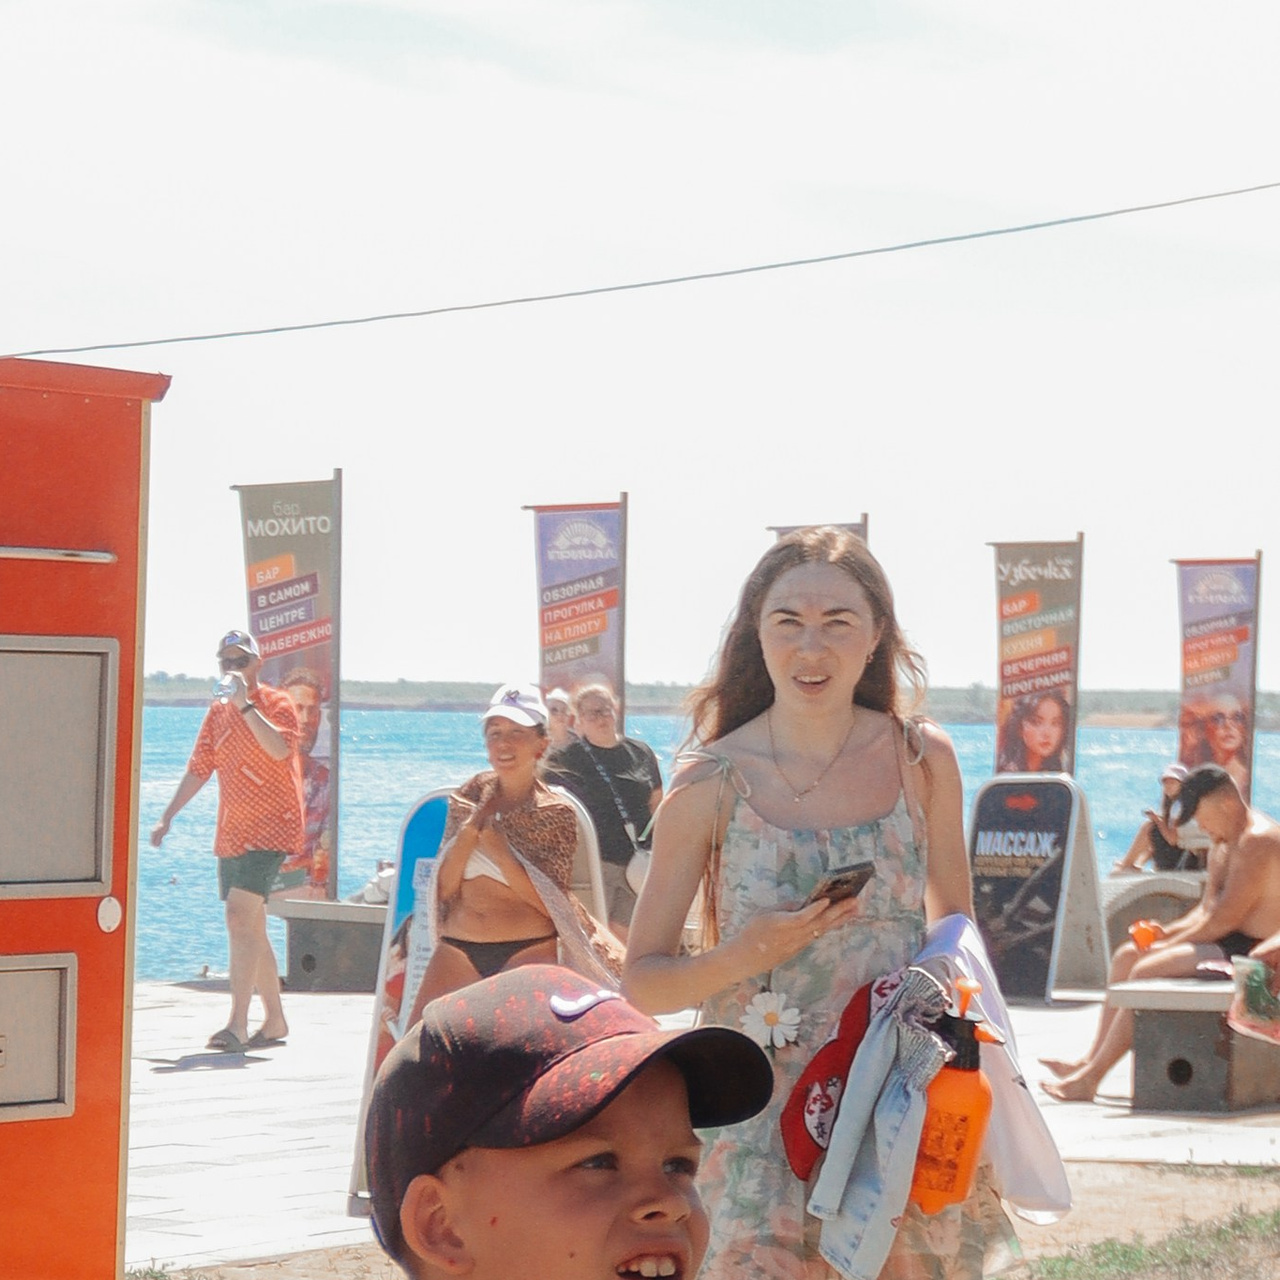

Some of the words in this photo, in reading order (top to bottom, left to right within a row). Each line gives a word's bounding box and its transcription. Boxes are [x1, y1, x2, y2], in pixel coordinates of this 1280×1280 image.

[247, 516, 331, 538] МОХИТО
[256, 566, 280, 584] БАР
[257, 595, 267, 608] В
[268, 581, 310, 605] САМОМ
[543, 576, 604, 603] ОБЗОРНАЯ
[259, 607, 306, 632] ЦЕНТРЕ
[543, 597, 604, 624] ПРОГУЛКА
[545, 629, 563, 644] НА
[545, 643, 590, 664] КАТЕРА
[1003, 651, 1068, 676] ВЕЧЕРНЯЯ
[1003, 670, 1072, 696] ПРОГРАММ
[976, 831, 1056, 856] МАССАЖ
